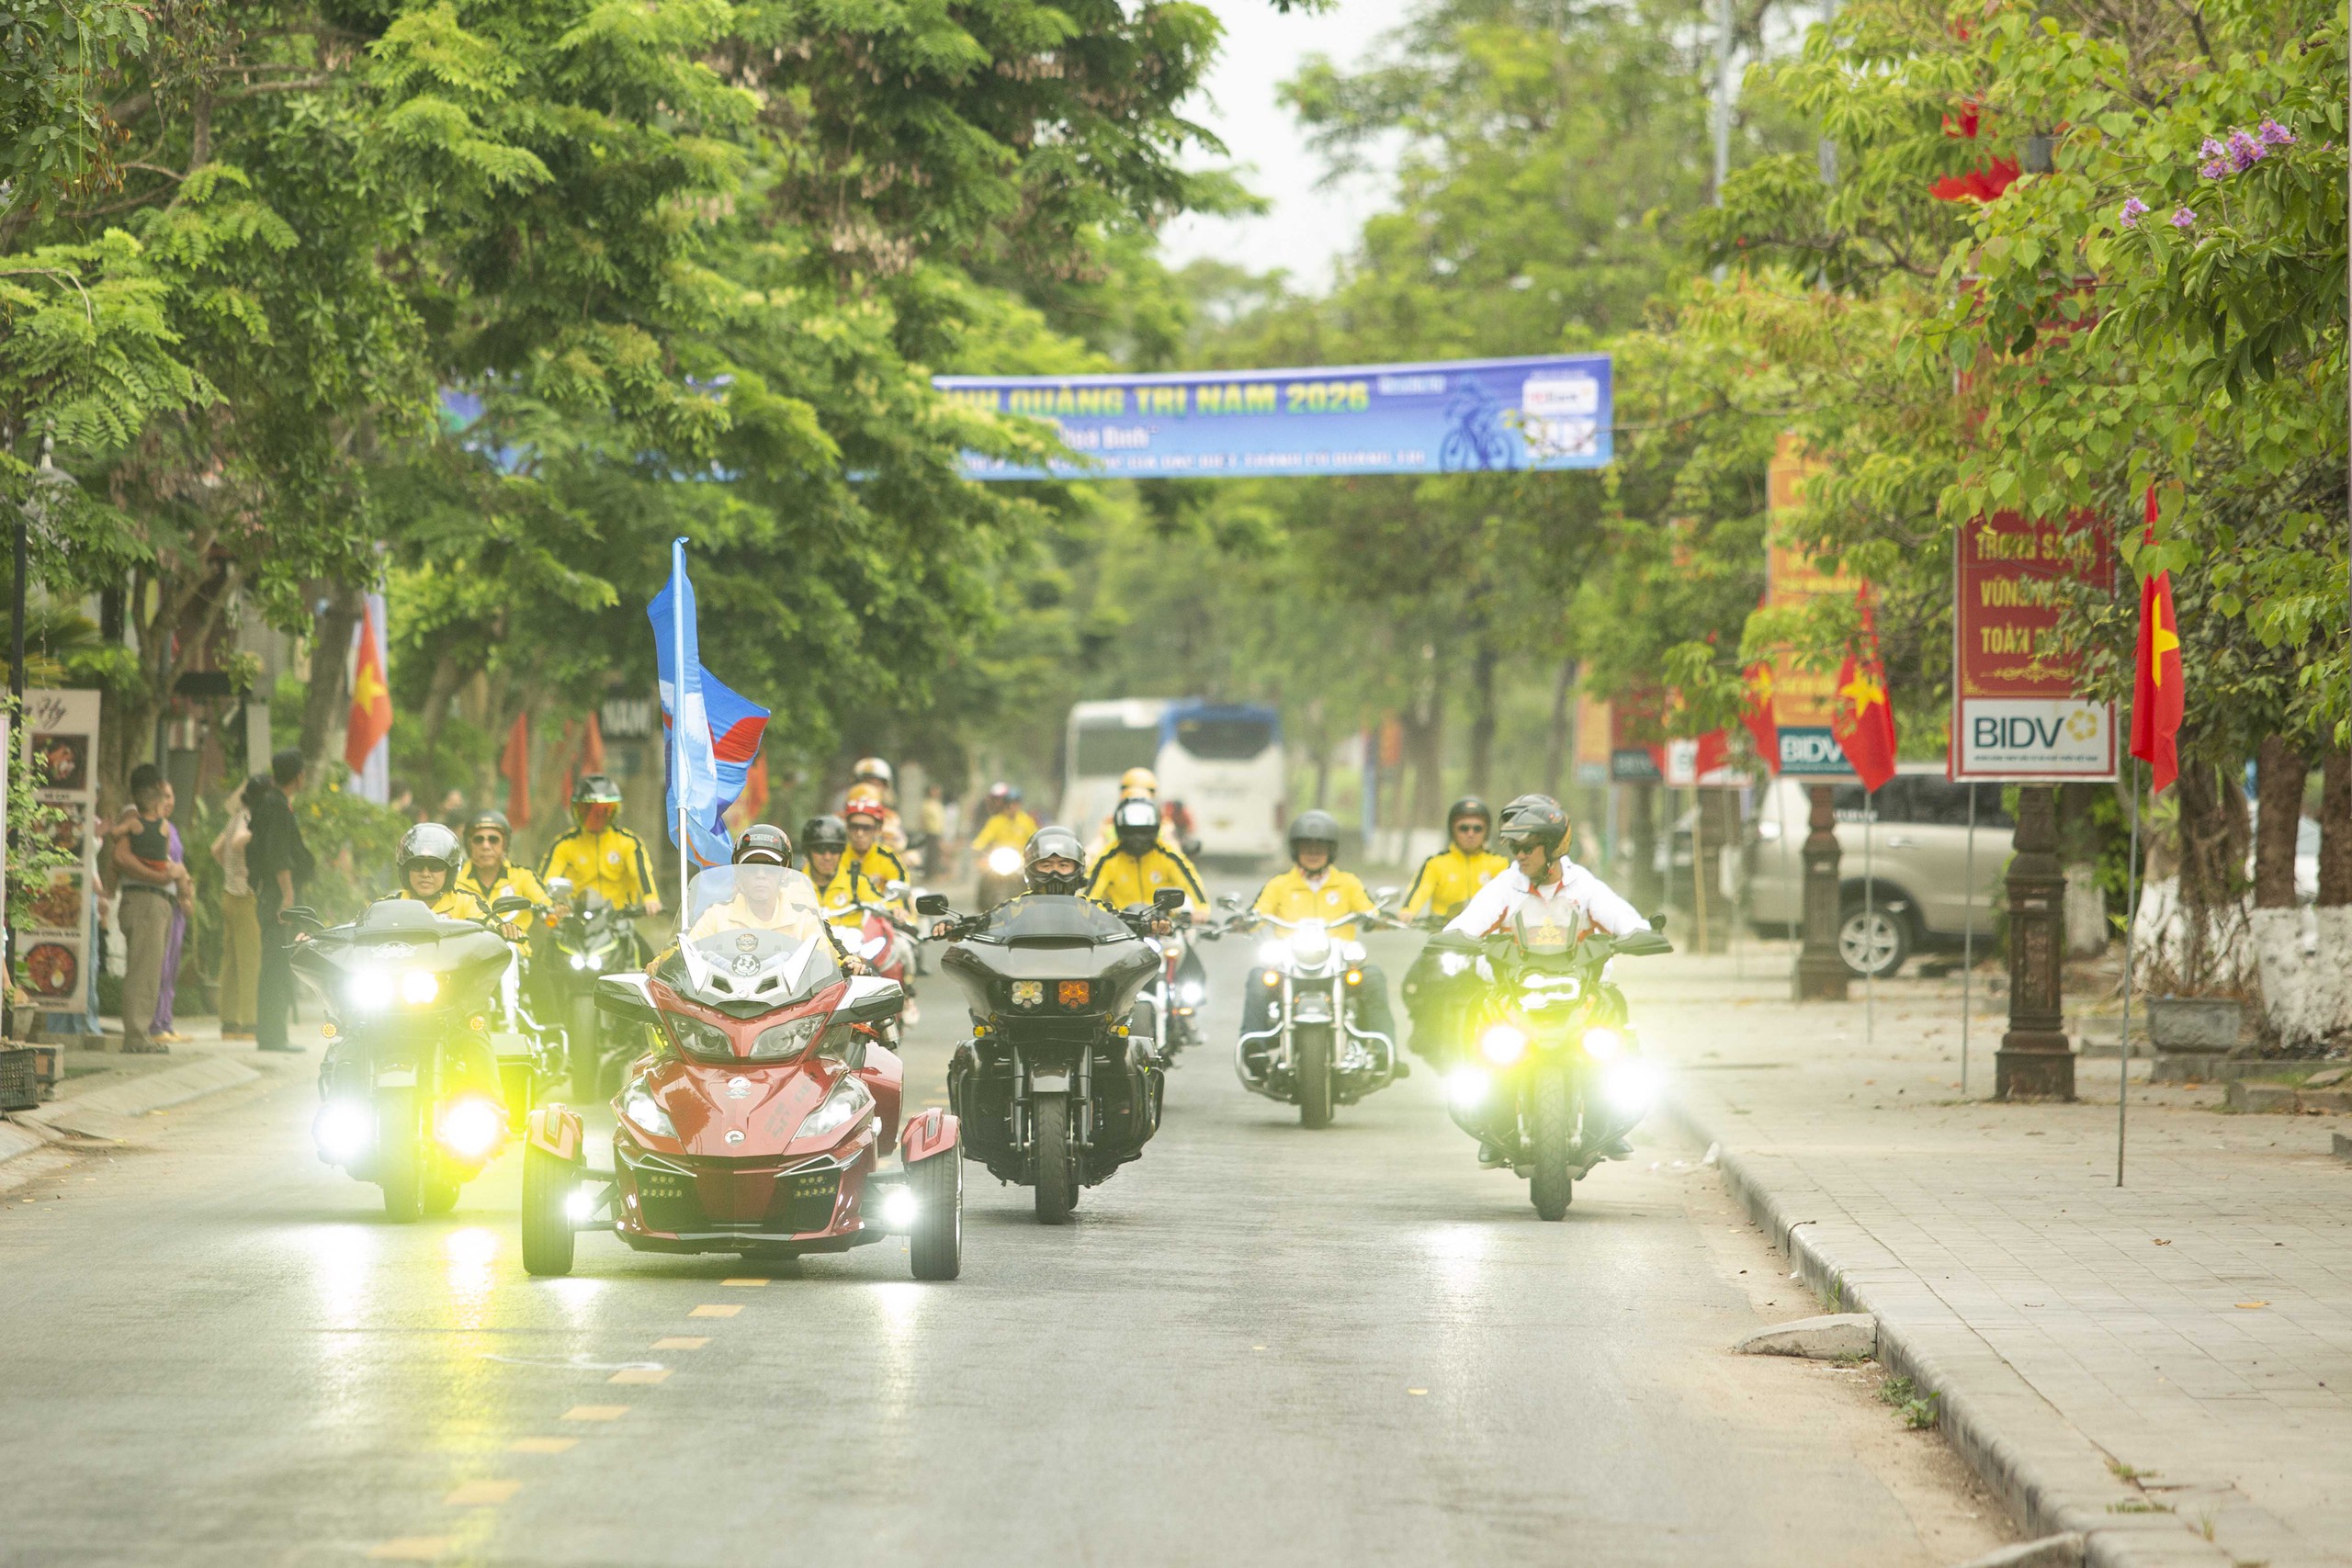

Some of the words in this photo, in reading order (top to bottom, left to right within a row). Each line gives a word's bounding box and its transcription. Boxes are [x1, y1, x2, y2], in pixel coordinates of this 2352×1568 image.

[1009, 382, 1125, 416] QUẢNG
[1285, 379, 1369, 413] 2026
[1780, 734, 1843, 764] BIDV
[1973, 716, 2065, 749] BIDV
